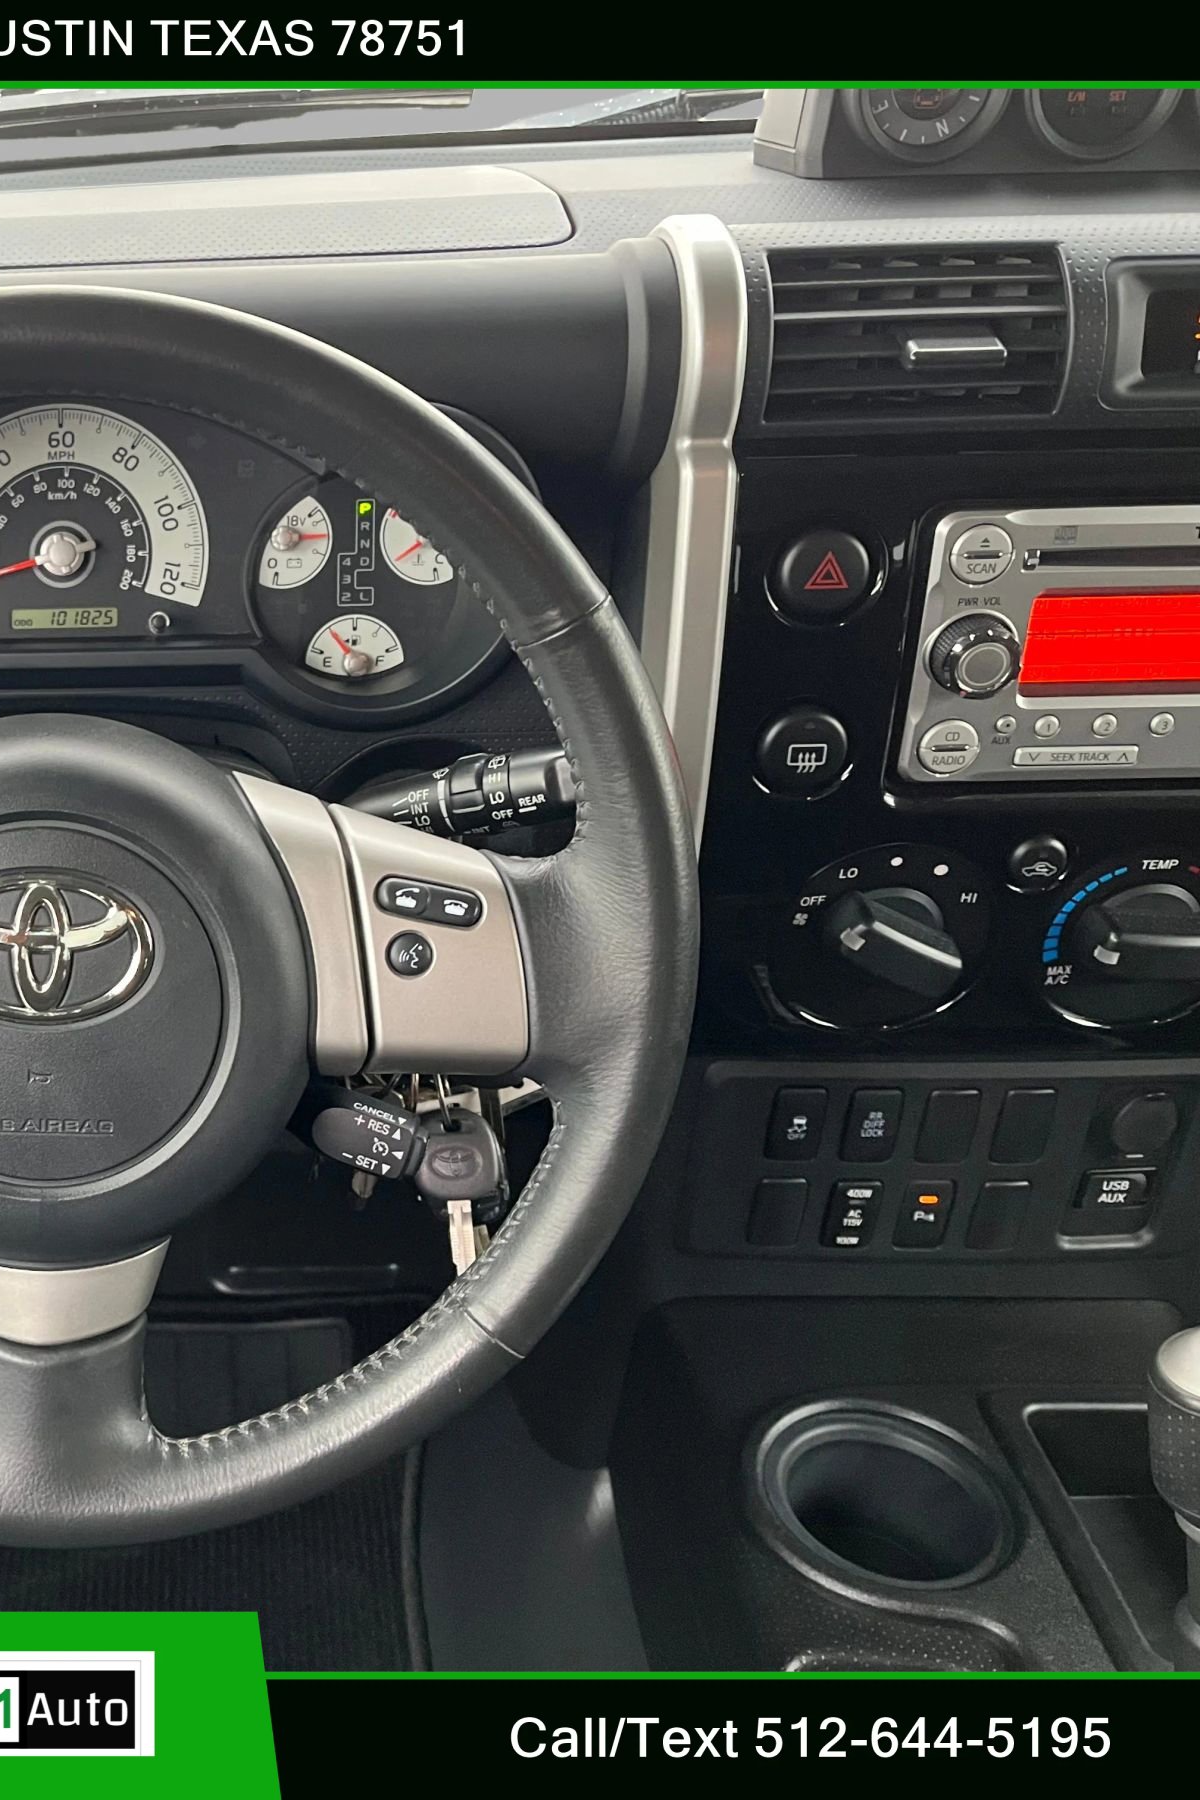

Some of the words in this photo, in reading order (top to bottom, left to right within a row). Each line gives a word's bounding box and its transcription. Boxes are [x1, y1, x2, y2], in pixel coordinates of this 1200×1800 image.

[48, 431, 75, 448] 60
[48, 451, 75, 461] MPH
[112, 447, 139, 471] 80
[33, 482, 48, 494] 80
[57, 479, 75, 489] 100
[83, 483, 100, 497] 120
[11, 495, 25, 508] 60
[48, 491, 77, 501] km/h
[105, 496, 121, 514] 140
[359, 502, 371, 514] P
[153, 496, 179, 532] 100
[120, 519, 134, 537] 160
[361, 522, 370, 531] R
[361, 539, 370, 548] N
[126, 544, 135, 563] 180
[342, 558, 351, 566] 4
[360, 557, 369, 566] D
[966, 563, 997, 575] SCAN
[120, 569, 133, 590] 200
[160, 562, 181, 595] 120
[342, 575, 351, 584] 3
[342, 592, 351, 602] 2
[360, 592, 369, 601] L
[957, 597, 979, 606] PWR
[50, 610, 113, 626] 101825
[323, 656, 331, 667] E
[375, 656, 384, 667] F
[1104, 722, 1111, 731] 2
[1161, 721, 1168, 731] 3
[945, 732, 960, 742] CD
[991, 735, 1011, 745] AUX
[931, 755, 965, 766] RADIO
[1050, 752, 1075, 762] SEEK
[1078, 752, 1111, 761] TRACK
[488, 772, 502, 784] HI
[408, 789, 430, 803] OFF
[489, 791, 505, 805] LO
[518, 794, 546, 808] REAR
[410, 802, 429, 815] INT
[416, 815, 431, 827] LO
[491, 809, 514, 821] OFF
[1142, 859, 1180, 870] TEMP
[839, 868, 858, 879] LO
[800, 895, 826, 907] OFF
[960, 892, 978, 904] HI
[1047, 965, 1072, 976] MAX
[1044, 975, 1069, 986] A/C
[353, 1102, 396, 1123] CANCEL
[21, 1118, 114, 1134] AIRBAG
[367, 1119, 391, 1136] RES
[860, 1129, 884, 1138] LOCK
[355, 1155, 378, 1171] SET
[1102, 1180, 1130, 1192] USB
[1097, 1193, 1128, 1204] AUX
